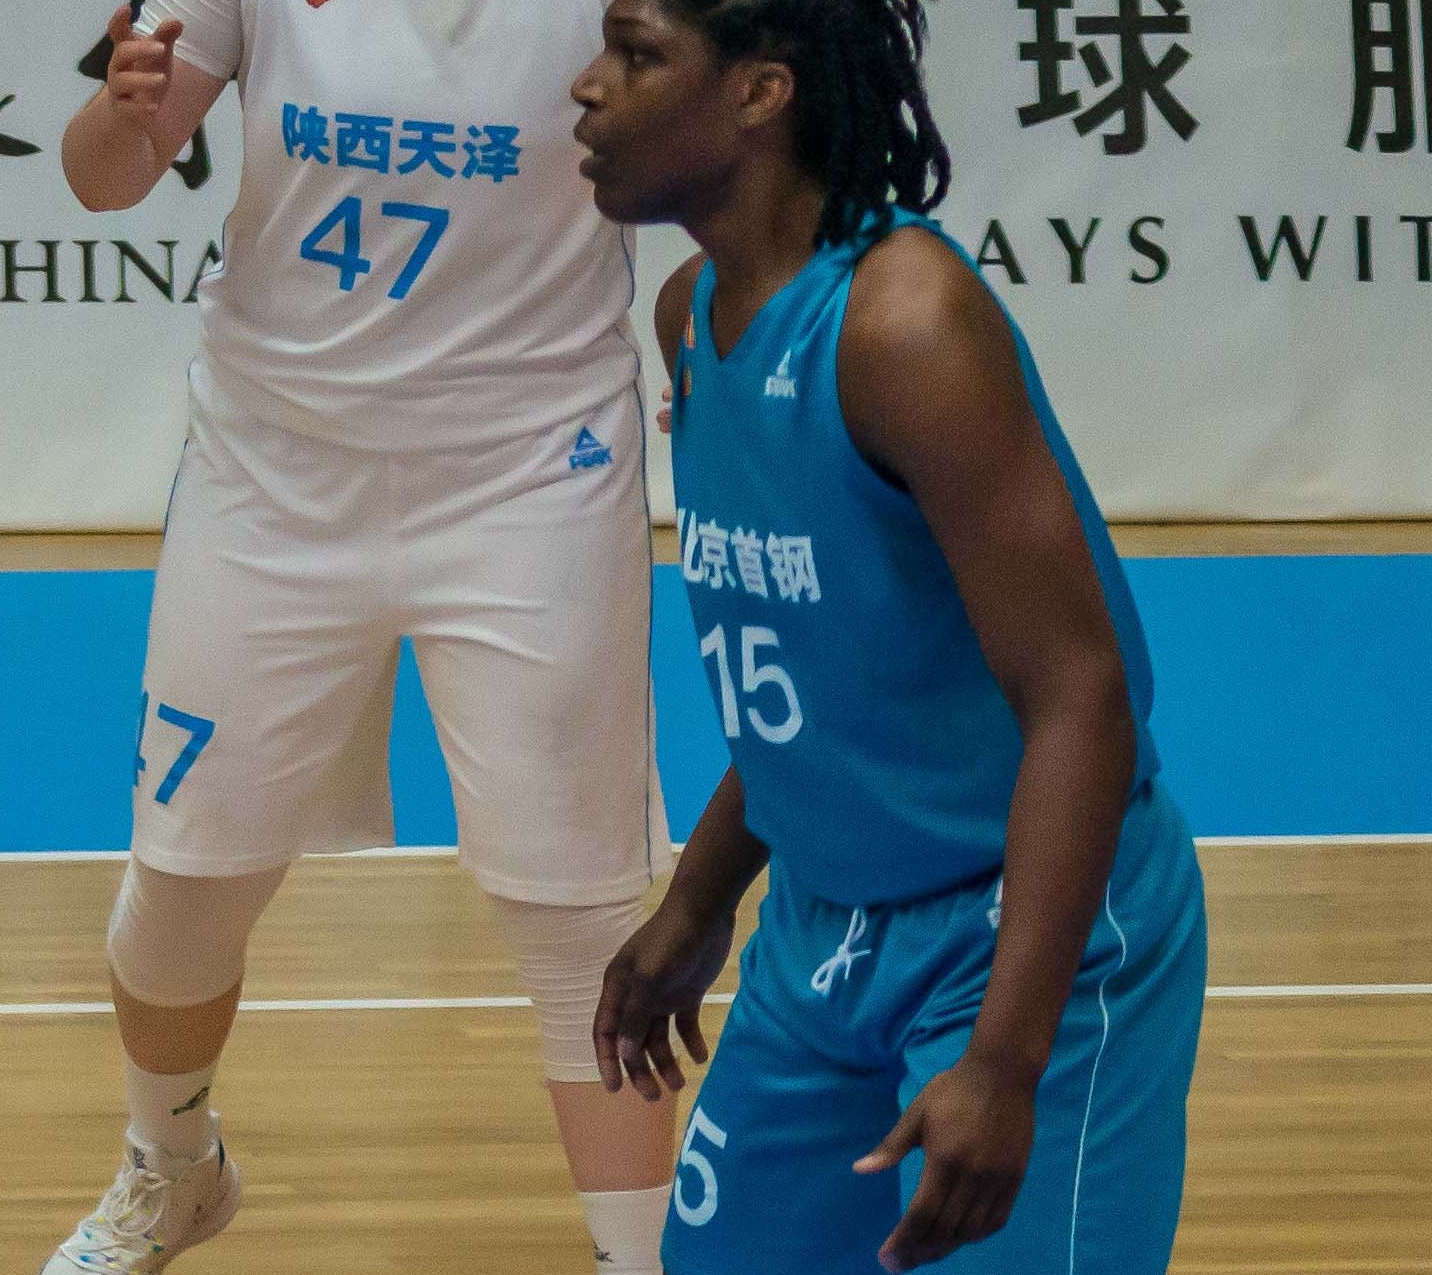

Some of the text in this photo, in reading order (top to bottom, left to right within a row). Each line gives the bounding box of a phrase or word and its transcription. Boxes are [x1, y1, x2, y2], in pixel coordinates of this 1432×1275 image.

[282, 102, 521, 183] 陕西天泽
[300, 195, 450, 300] 47
[700, 622, 803, 745] 15
